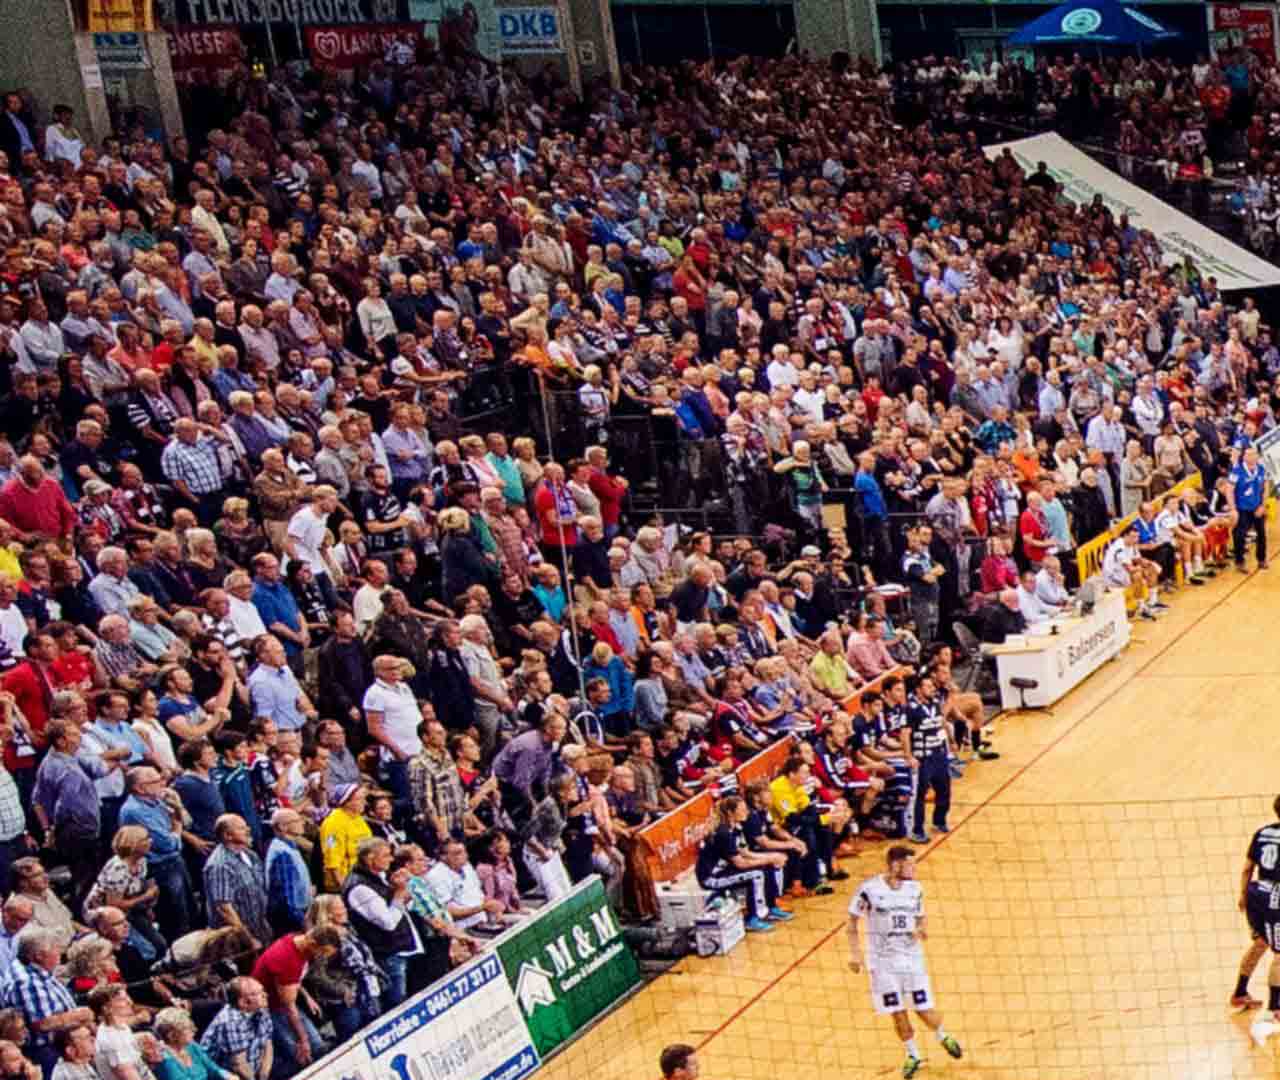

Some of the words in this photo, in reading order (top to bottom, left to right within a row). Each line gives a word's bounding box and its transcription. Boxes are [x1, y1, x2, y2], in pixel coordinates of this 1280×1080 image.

[499, 14, 555, 36] DKB
[544, 934, 577, 978] M
[571, 924, 597, 960] &
[588, 904, 620, 947] M
